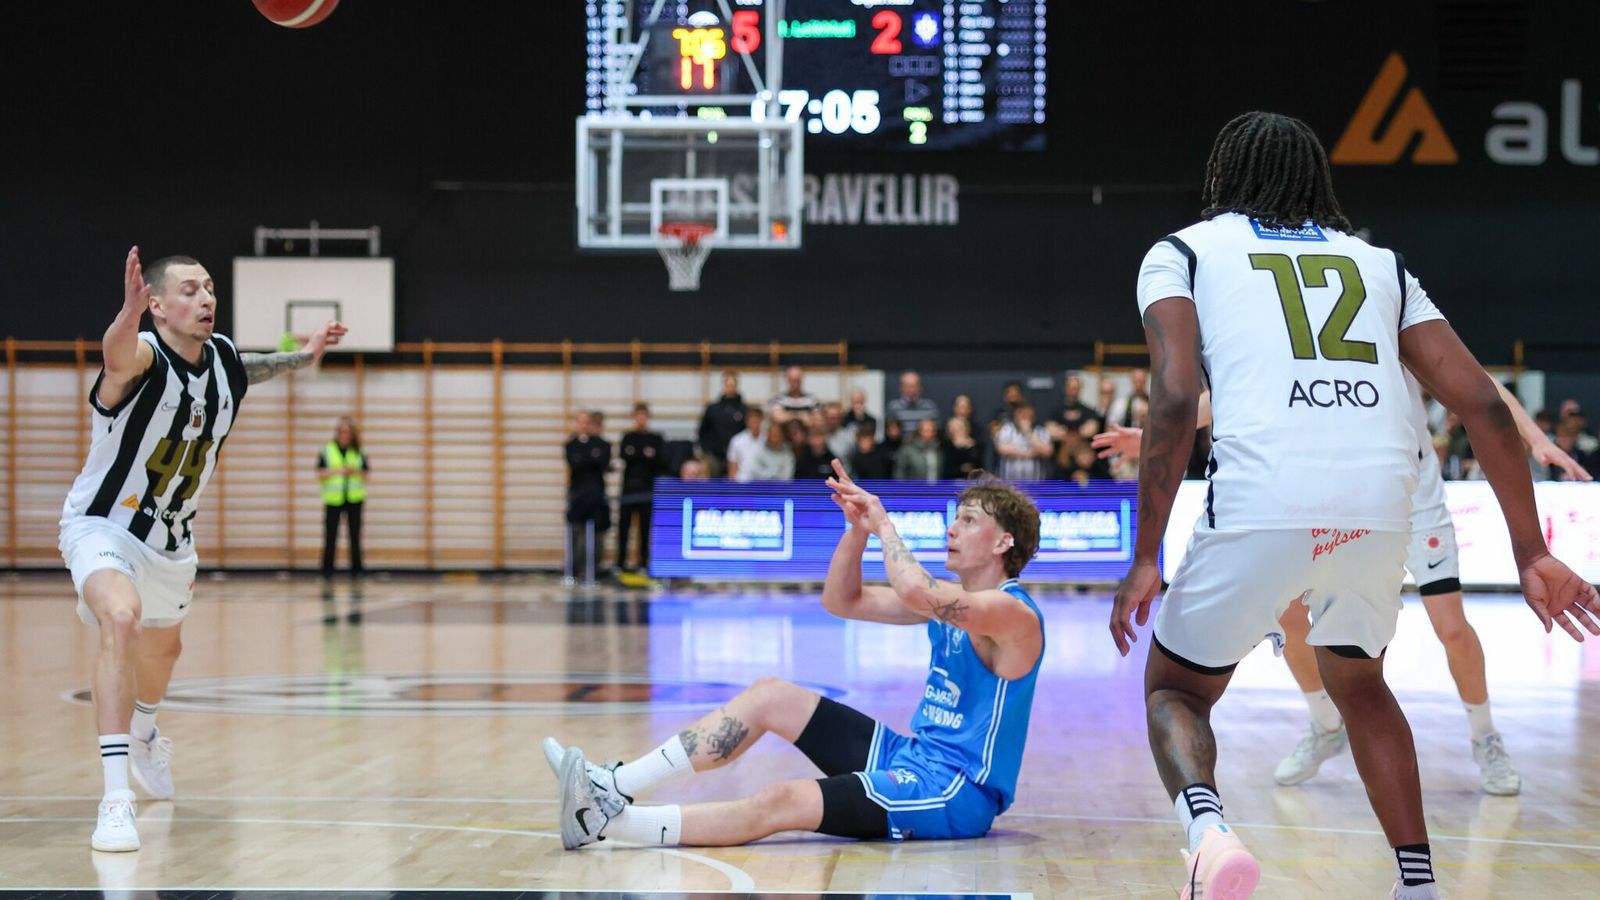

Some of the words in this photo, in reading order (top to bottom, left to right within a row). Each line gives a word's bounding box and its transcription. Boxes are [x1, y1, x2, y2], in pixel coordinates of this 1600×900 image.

[731, 11, 761, 54] 5
[871, 10, 902, 54] 2
[1248, 253, 1378, 364] 12
[1288, 379, 1379, 408] ACRO
[145, 437, 215, 499] 44
